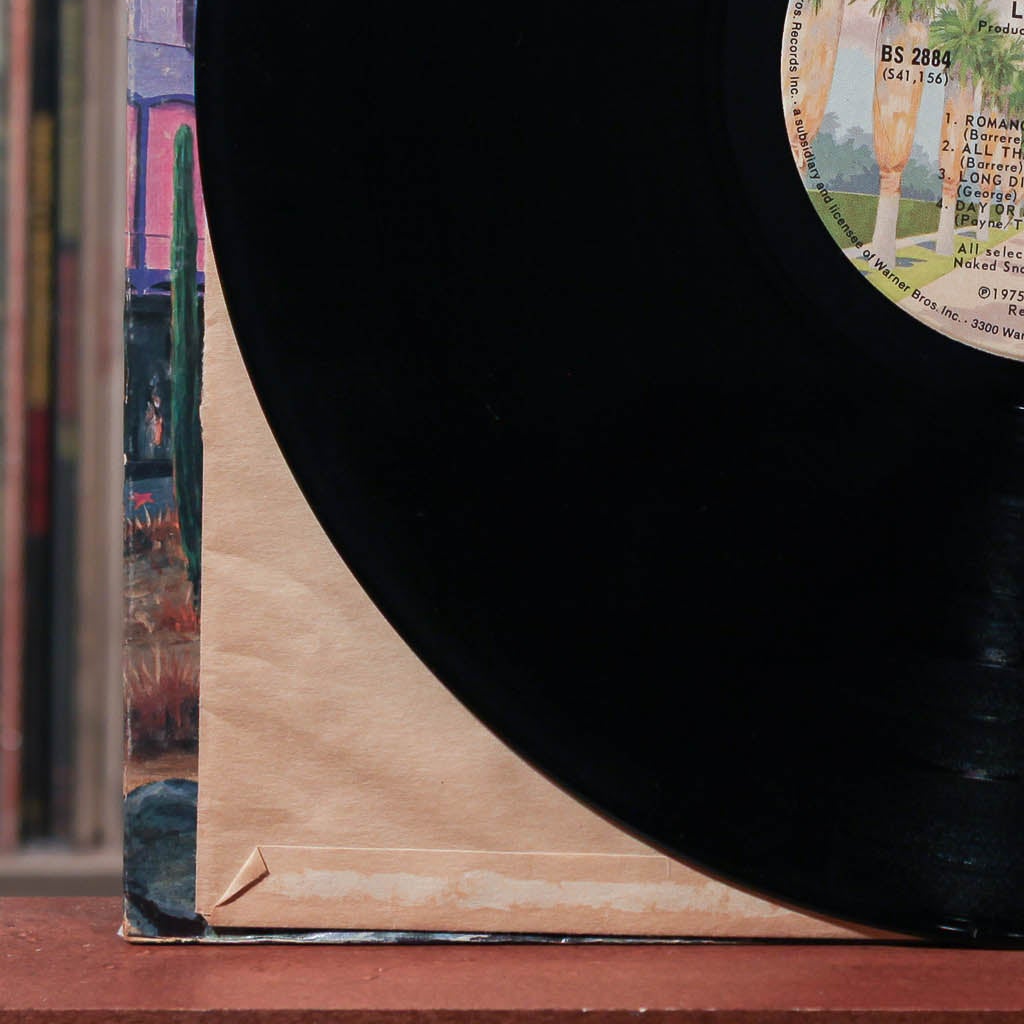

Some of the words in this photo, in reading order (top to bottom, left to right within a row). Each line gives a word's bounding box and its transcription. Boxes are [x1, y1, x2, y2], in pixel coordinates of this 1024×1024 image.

[789, 22, 801, 72] Records
[881, 45, 904, 63] BS
[912, 47, 951, 68] 2884
[883, 68, 949, 86] (S41,156)
[789, 75, 800, 98] Inc.
[945, 113, 958, 125] 1.
[795, 119, 820, 179] subsidiary
[942, 140, 955, 152] 2.
[962, 143, 993, 156] ALL
[960, 157, 1023, 174] (Barrere)
[938, 168, 951, 180] 3.
[959, 171, 1002, 186] LONG
[816, 182, 833, 207] and
[957, 185, 1017, 202] (George)
[956, 199, 988, 214] DAY
[995, 204, 1015, 216] OR
[829, 204, 863, 249] licensee
[862, 249, 875, 263] of
[957, 243, 979, 255] All
[953, 257, 996, 271] Naked
[873, 259, 911, 293] Warner
[911, 289, 940, 312] Bros.
[941, 305, 961, 323] Inc.
[971, 318, 999, 335] 3300
